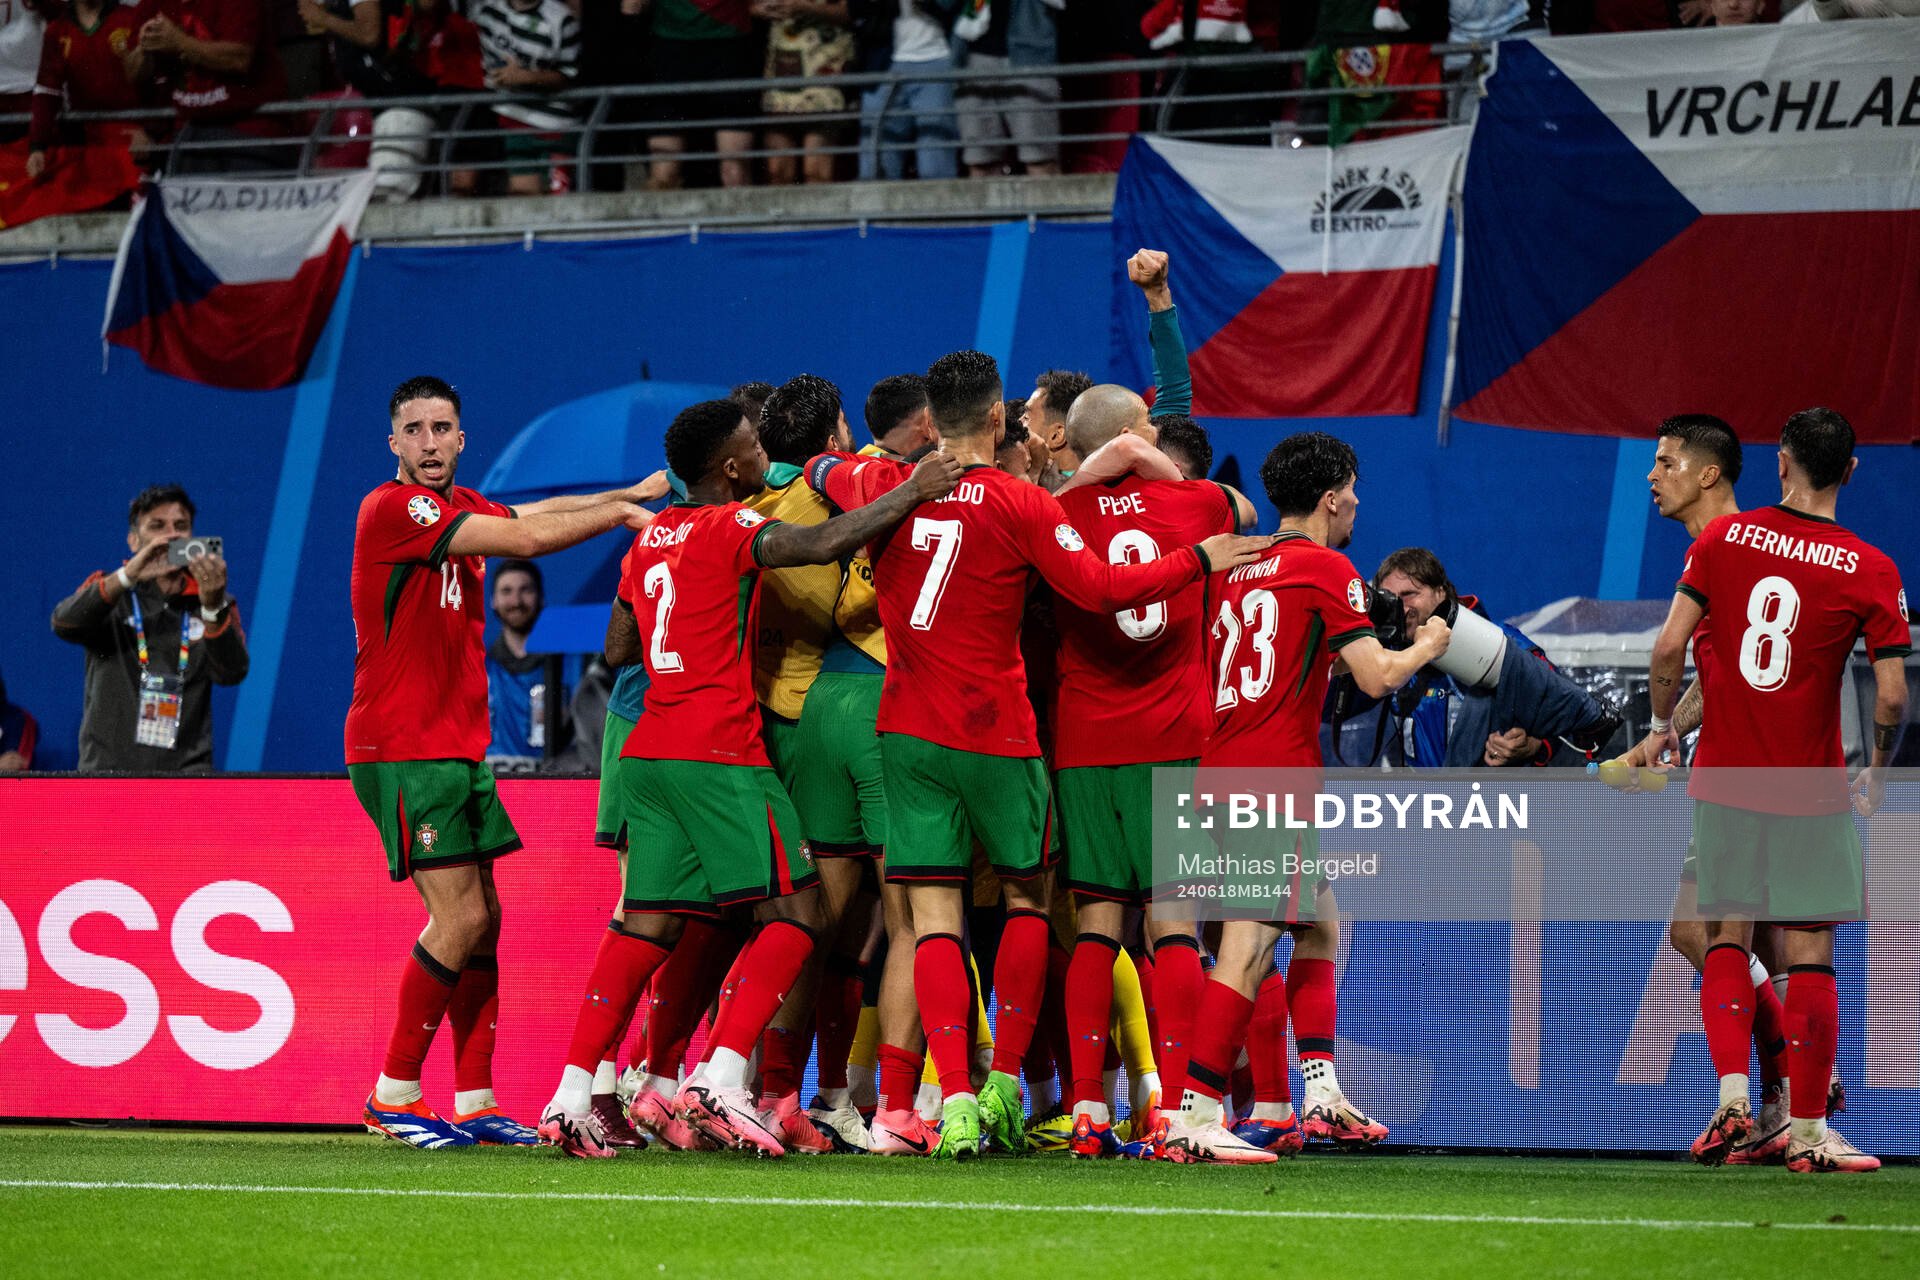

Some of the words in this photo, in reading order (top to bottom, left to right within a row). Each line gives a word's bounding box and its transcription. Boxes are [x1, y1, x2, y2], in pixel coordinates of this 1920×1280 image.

[1098, 492, 1146, 516] PEPE
[1725, 523, 1860, 575] B.FERNANDES
[440, 561, 462, 611] 14
[644, 561, 684, 674] 2
[911, 517, 963, 631] 7
[1211, 588, 1279, 713] 23
[1739, 576, 1800, 692] 8
[0, 879, 296, 1070] ss
